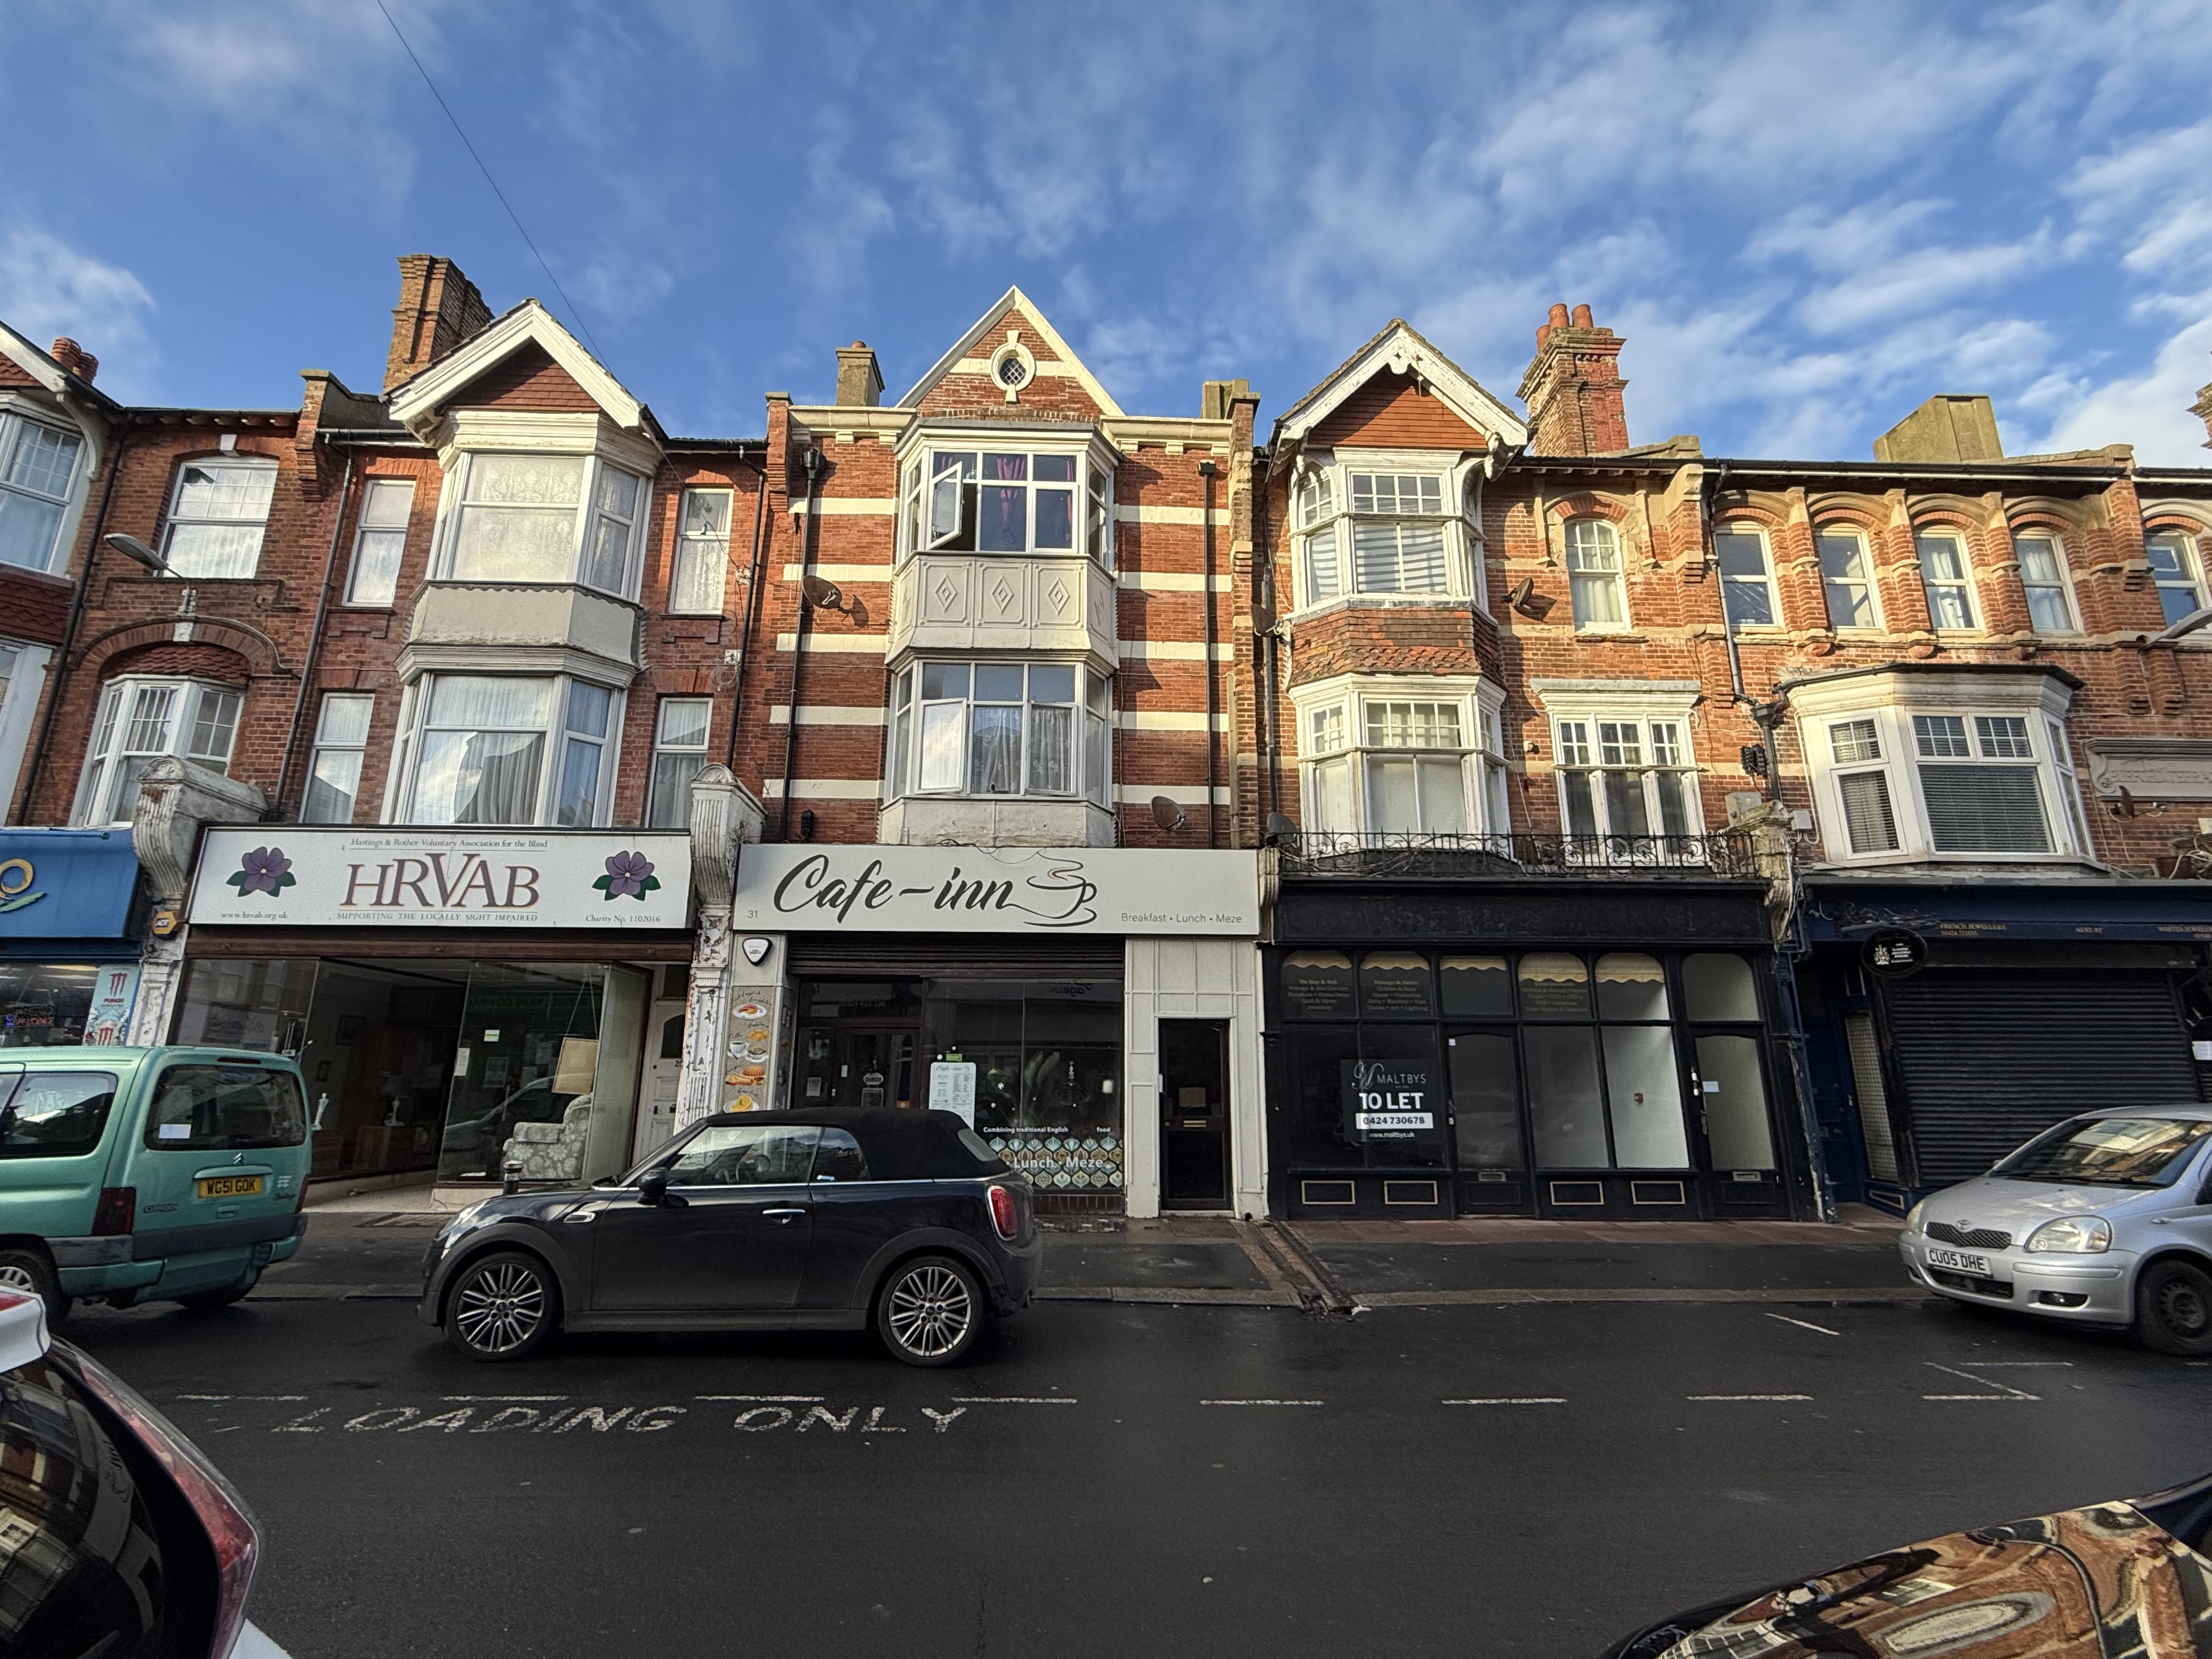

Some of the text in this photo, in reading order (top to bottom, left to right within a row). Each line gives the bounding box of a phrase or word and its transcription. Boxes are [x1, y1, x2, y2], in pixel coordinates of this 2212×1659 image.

[351, 838, 383, 848] Hastings
[421, 839, 457, 848] Voluntary
[340, 853, 540, 909] HRVAB
[420, 913, 461, 921] LOCALLY
[747, 910, 758, 918] 31
[1121, 913, 1243, 923] Breakfast Lunch Meze
[585, 915, 612, 924] Charity
[1377, 1074, 1426, 1084] MALTBYS
[1358, 1092, 1424, 1110] TO LET
[1014, 1156, 1104, 1169] Lunch Meze
[1929, 1249, 1987, 1271] CU05 DHE
[273, 1406, 968, 1433] LOADING ONLY
